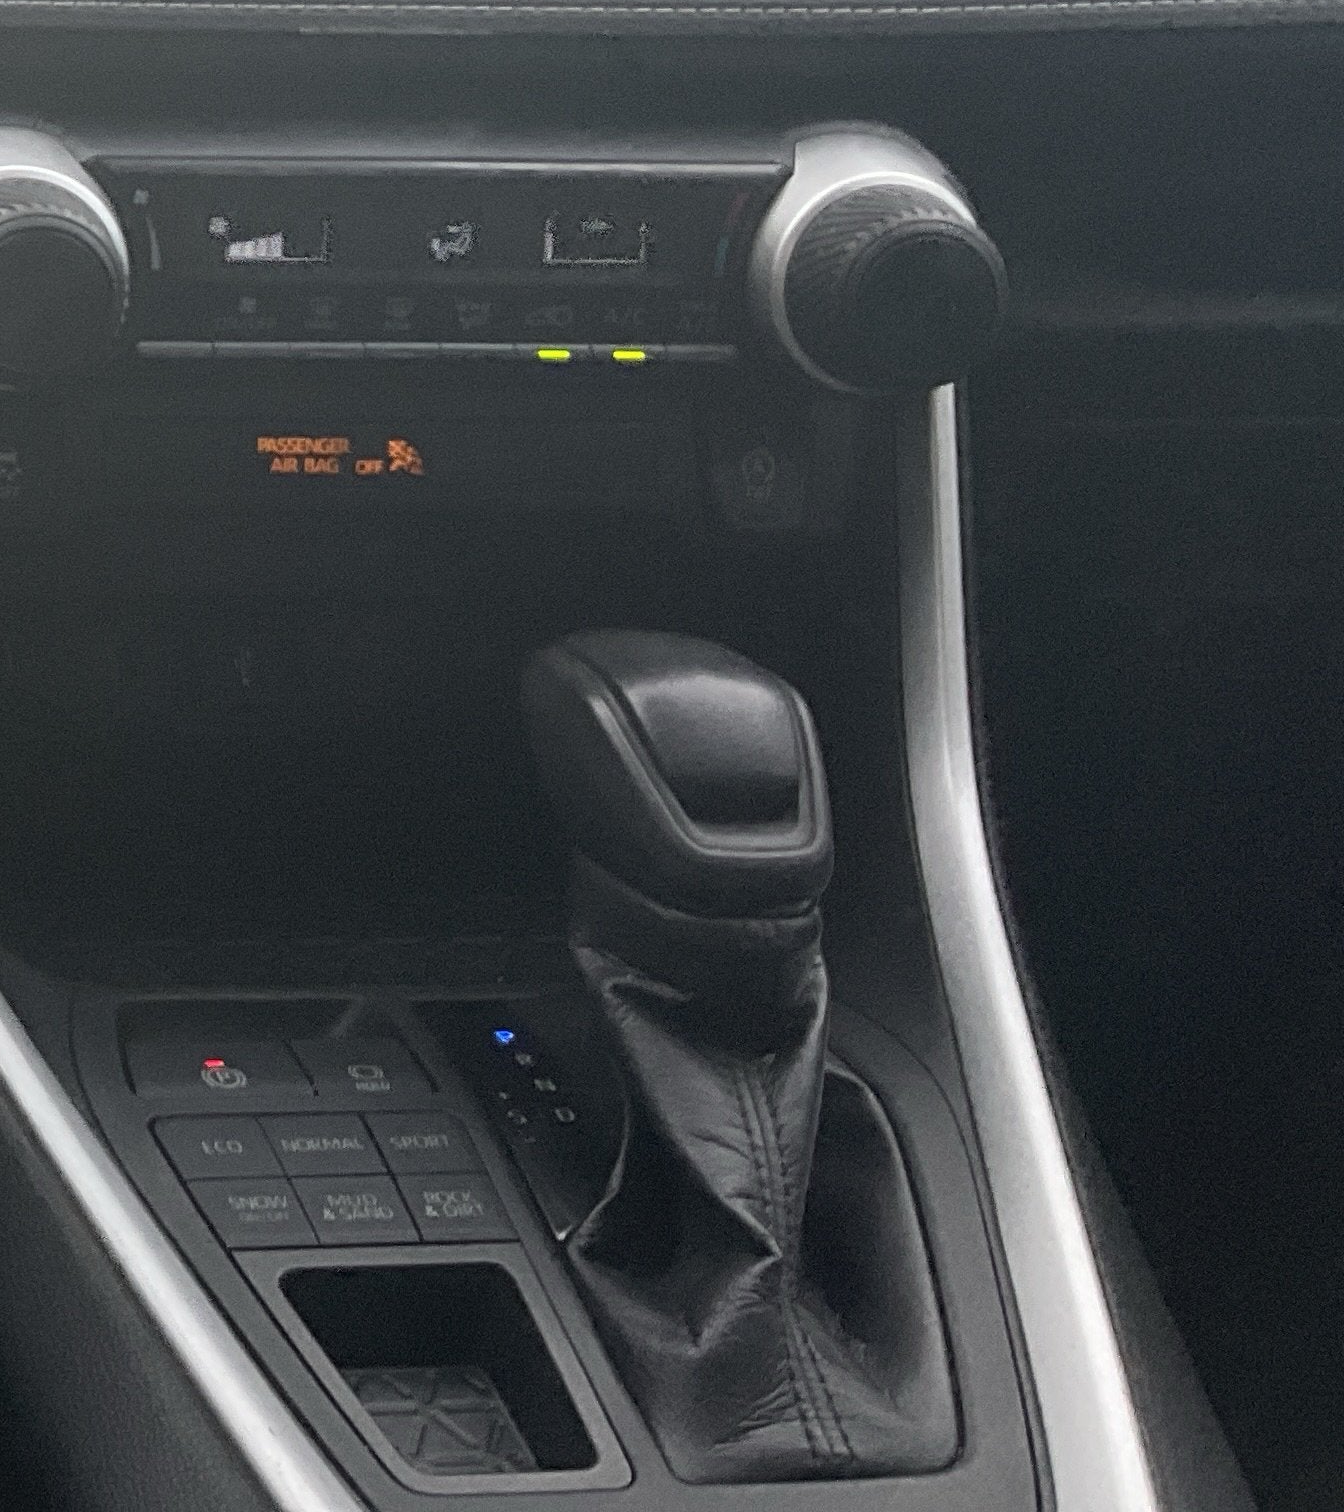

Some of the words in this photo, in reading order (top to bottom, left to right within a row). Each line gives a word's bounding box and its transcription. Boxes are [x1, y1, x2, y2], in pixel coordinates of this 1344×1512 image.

[257, 437, 350, 454] PASSENGER
[270, 457, 299, 473] AIR
[304, 457, 340, 473] BAG
[355, 459, 384, 475] OFF
[390, 1134, 450, 1150] SPORT
